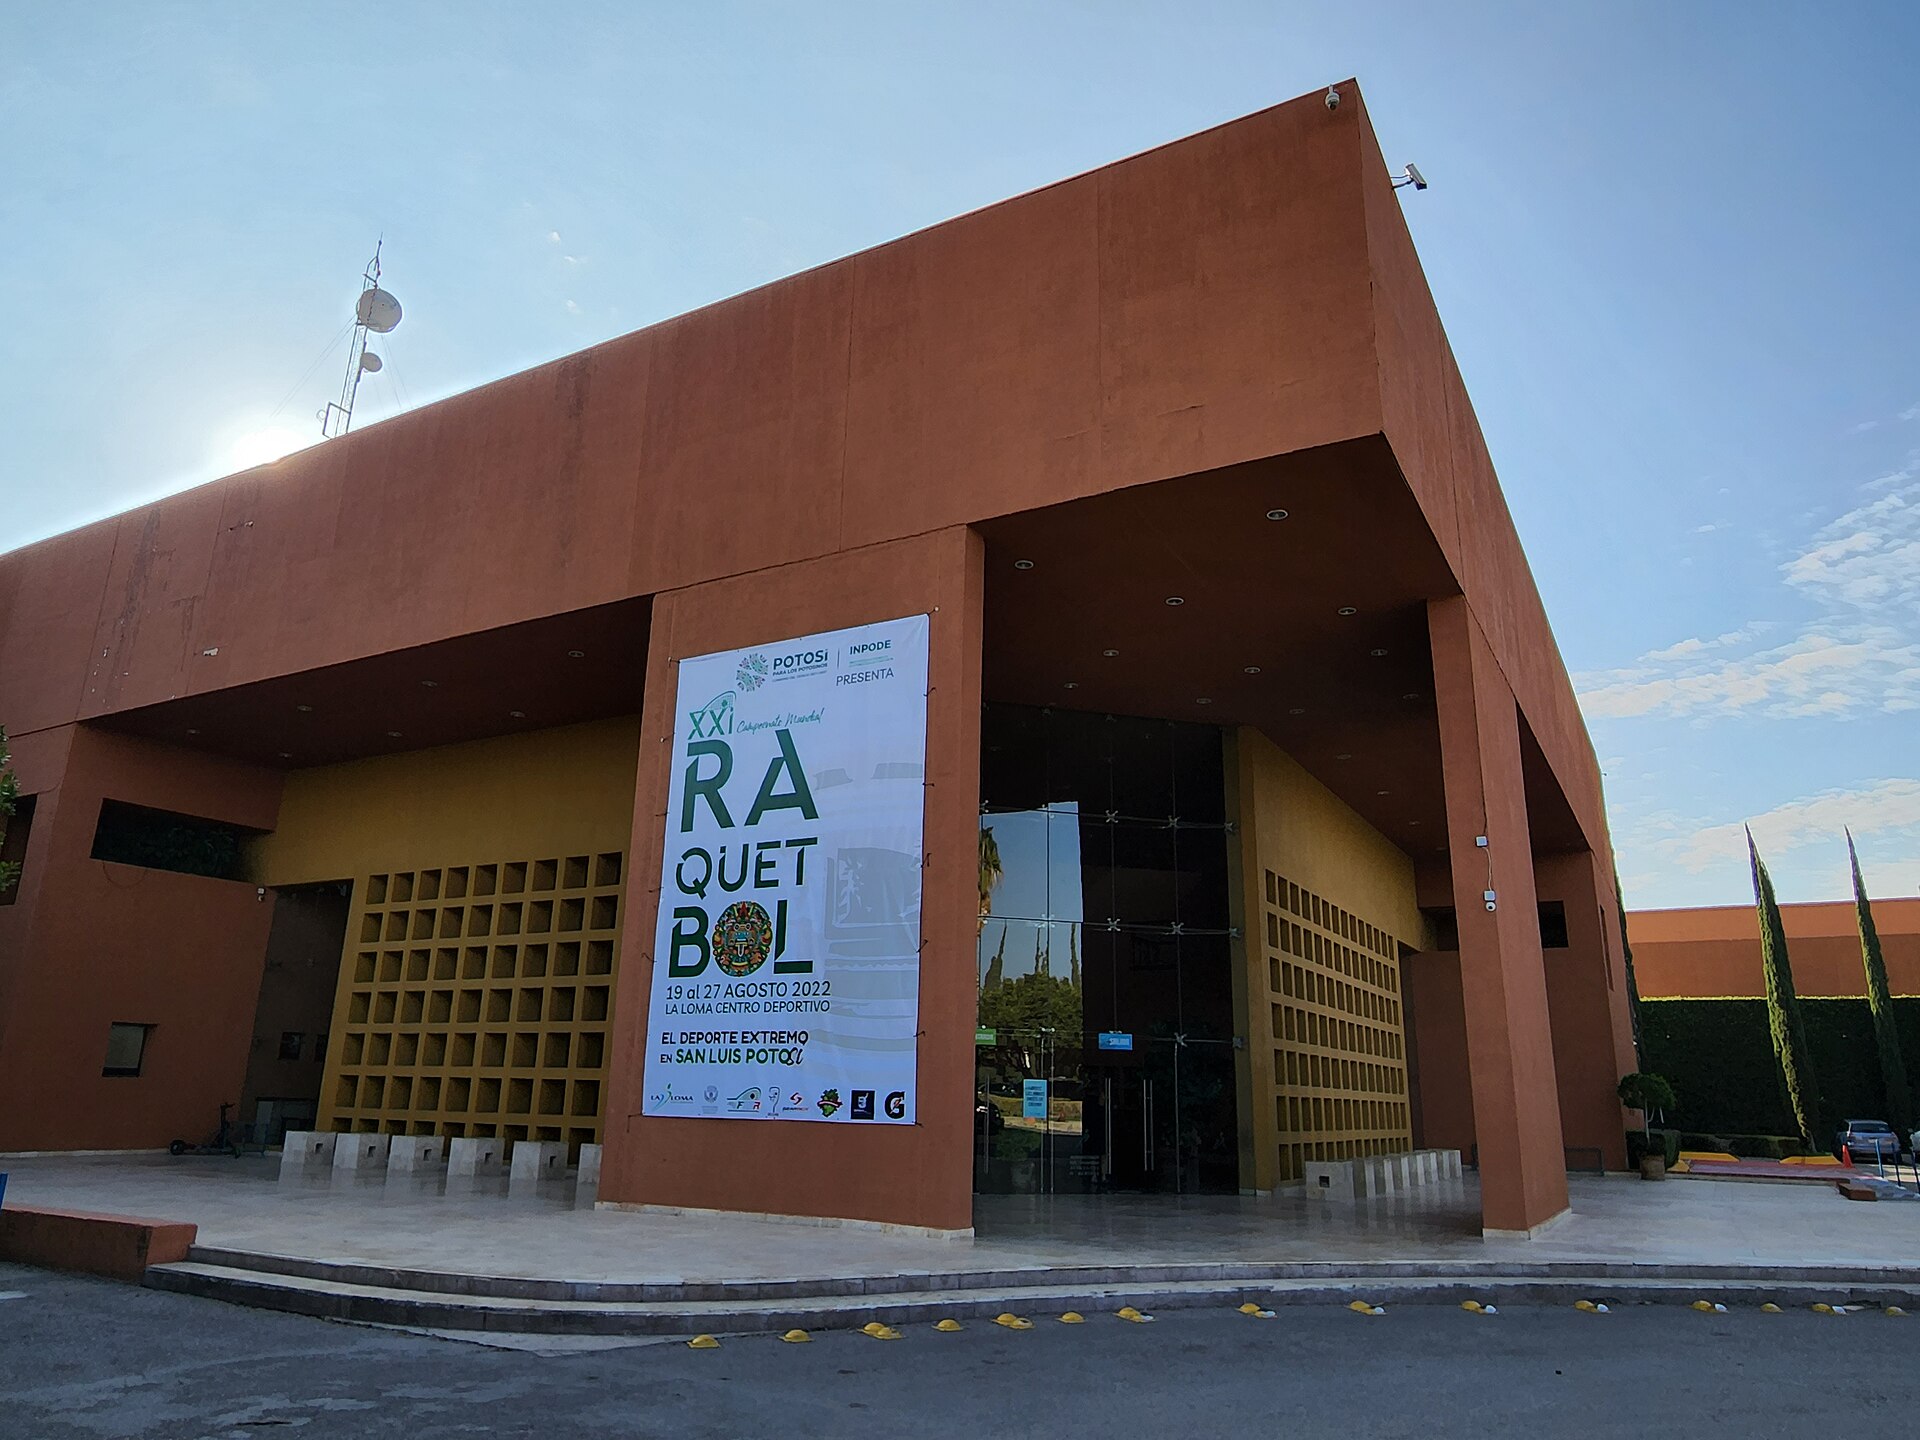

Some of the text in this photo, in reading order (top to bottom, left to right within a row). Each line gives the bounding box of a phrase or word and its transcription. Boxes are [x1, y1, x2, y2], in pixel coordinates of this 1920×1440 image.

[849, 640, 892, 655] INPODE
[798, 663, 828, 672] POTOSINOS
[836, 667, 895, 687] PRESENTA
[681, 728, 819, 833] RA
[675, 837, 818, 900] QUET
[666, 980, 832, 1000] 19 al 27 AGOSTO 2022
[665, 1000, 830, 1015] LA LOMA CENTRO DEPORTIVO
[661, 1030, 809, 1046] EL DEPORTE EXTREMO
[675, 1048, 705, 1064] SAN
[709, 1048, 742, 1064] LUIS
